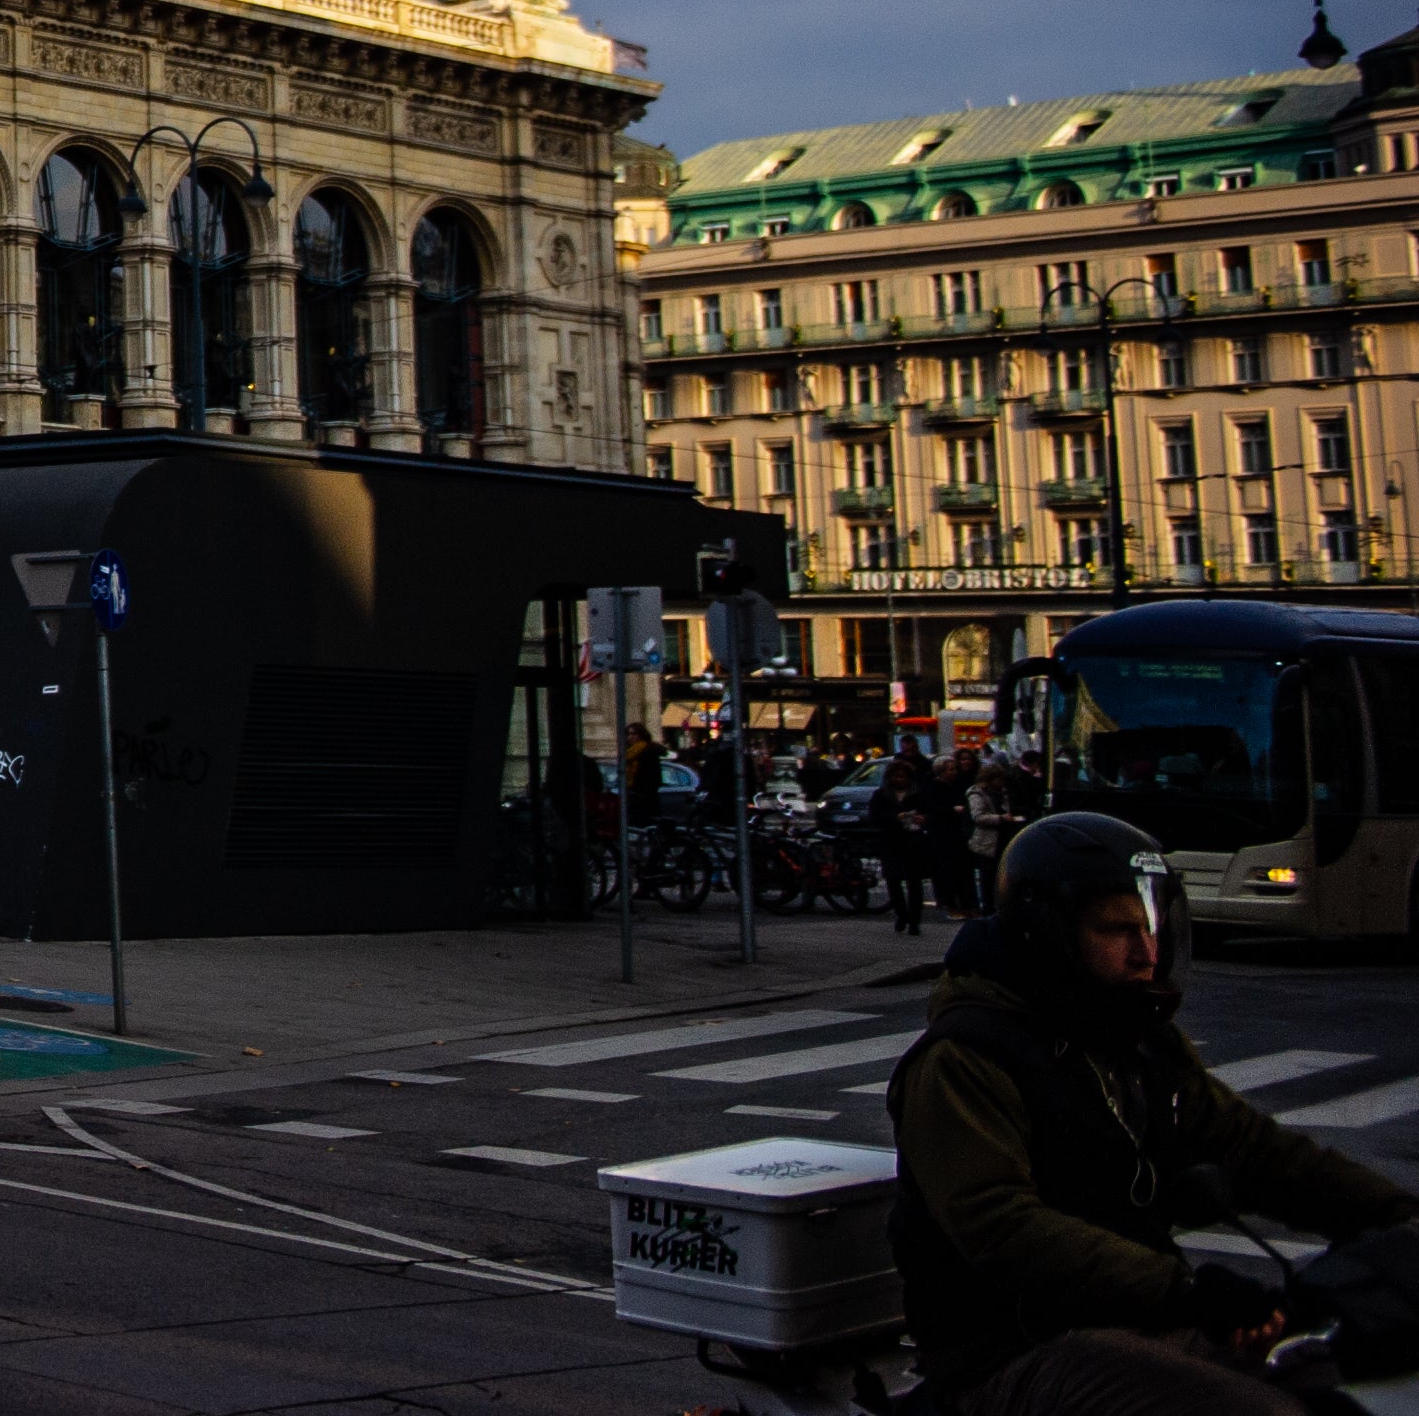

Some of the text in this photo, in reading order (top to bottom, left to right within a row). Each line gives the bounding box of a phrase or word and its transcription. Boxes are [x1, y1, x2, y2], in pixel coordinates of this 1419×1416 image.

[852, 567, 1091, 591] HOTEL BRISTOL
[628, 1196, 708, 1231] BLITZ
[630, 1231, 738, 1277] KURIER
